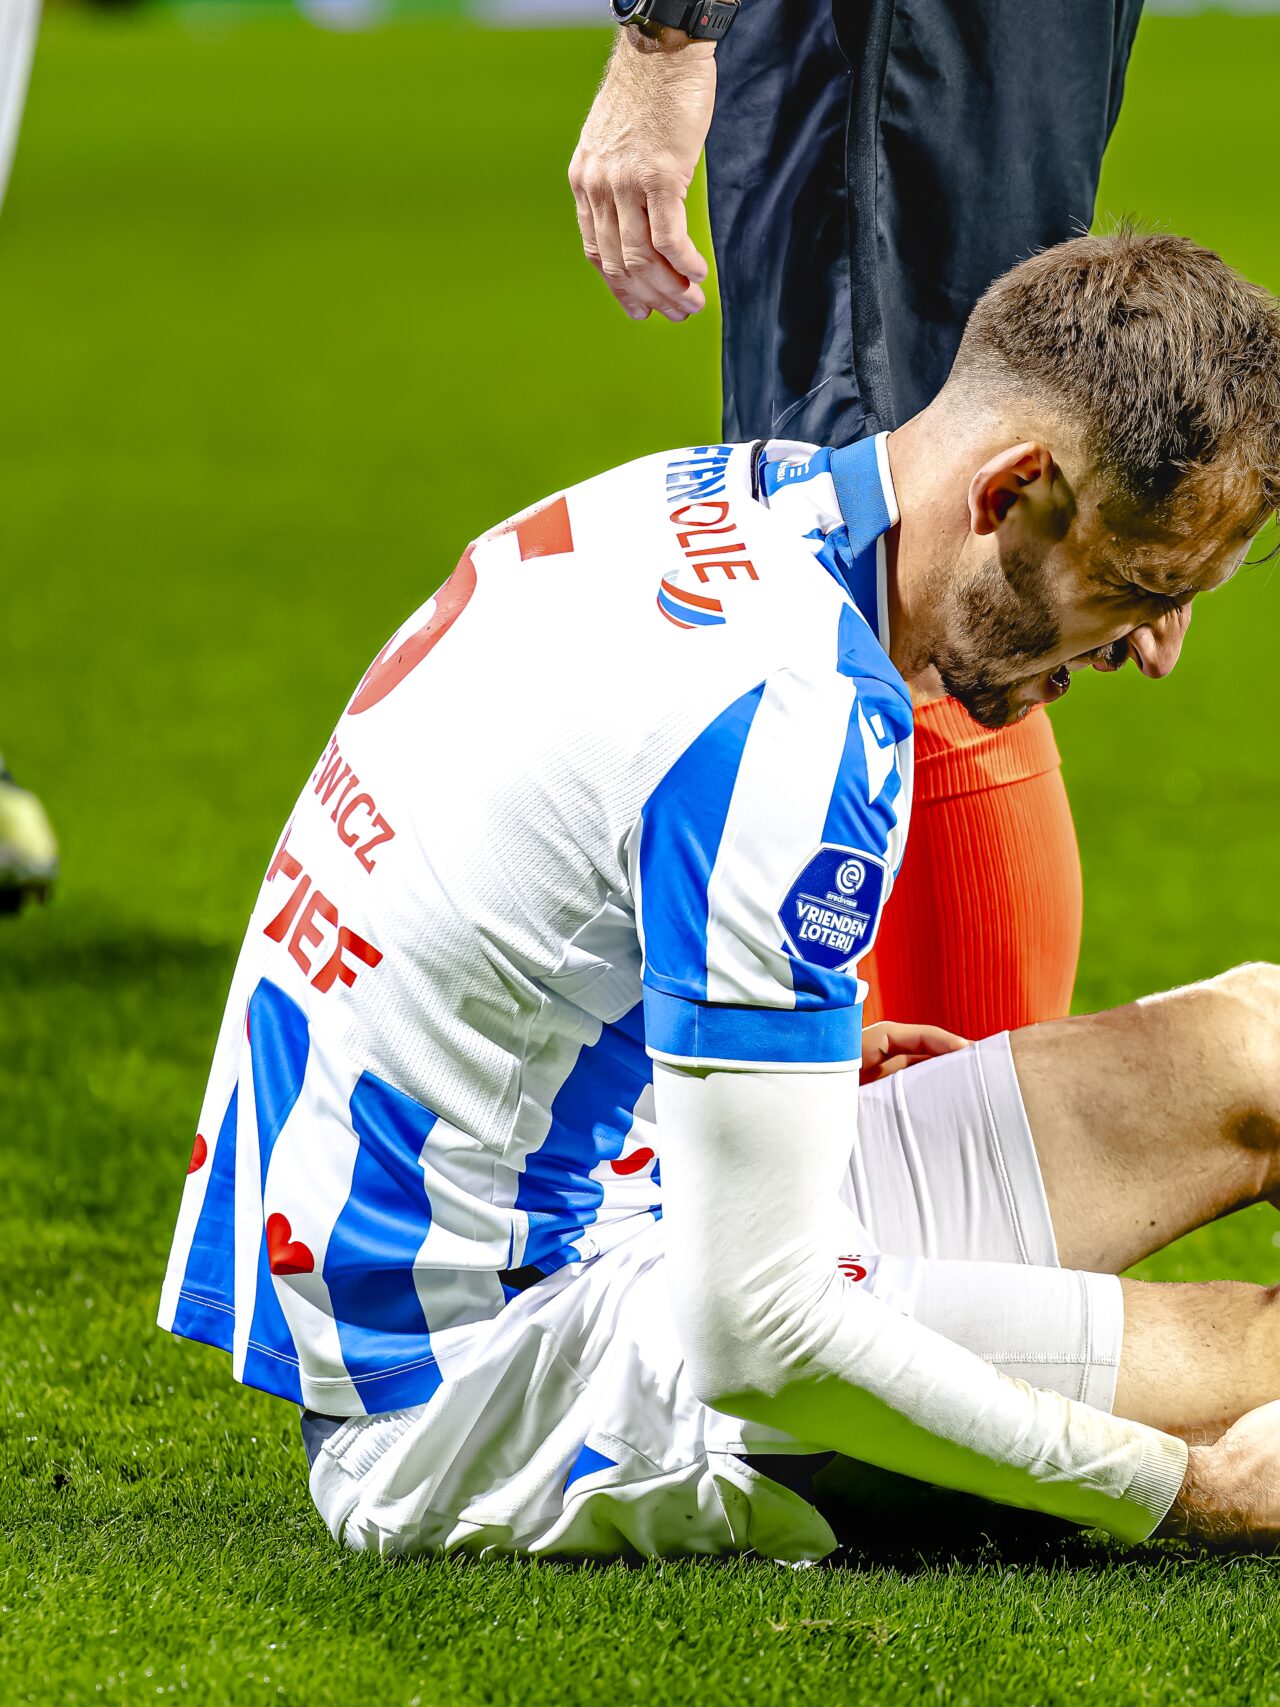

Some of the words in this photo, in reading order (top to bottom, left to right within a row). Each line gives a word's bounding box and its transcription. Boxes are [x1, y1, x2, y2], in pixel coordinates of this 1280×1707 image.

[313, 734, 396, 875] WICZ
[797, 901, 868, 938] VRIENDEN
[799, 921, 855, 953] LOTERIJ
